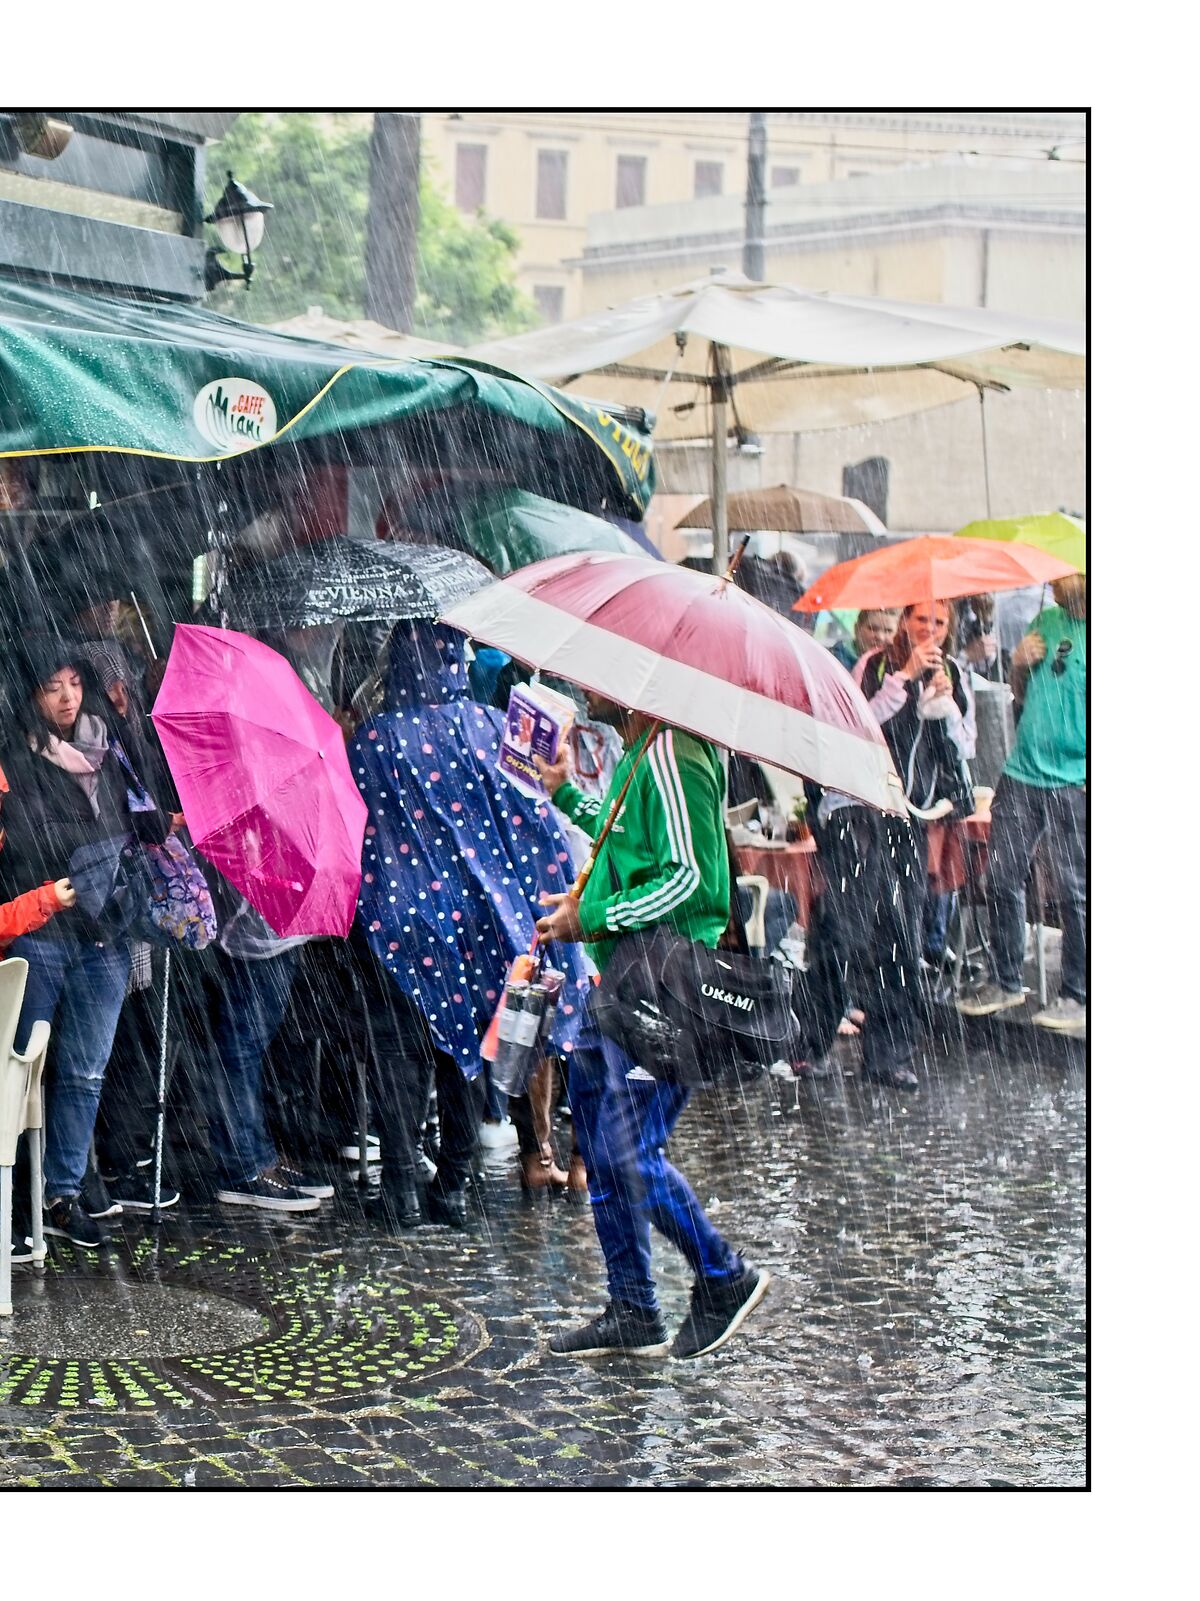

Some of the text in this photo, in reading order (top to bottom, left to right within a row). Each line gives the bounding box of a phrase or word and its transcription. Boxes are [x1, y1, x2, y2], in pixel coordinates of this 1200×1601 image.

[325, 585, 408, 601] VIENNA
[506, 755, 542, 781] PONCHO
[701, 983, 755, 1012] OK&MI
